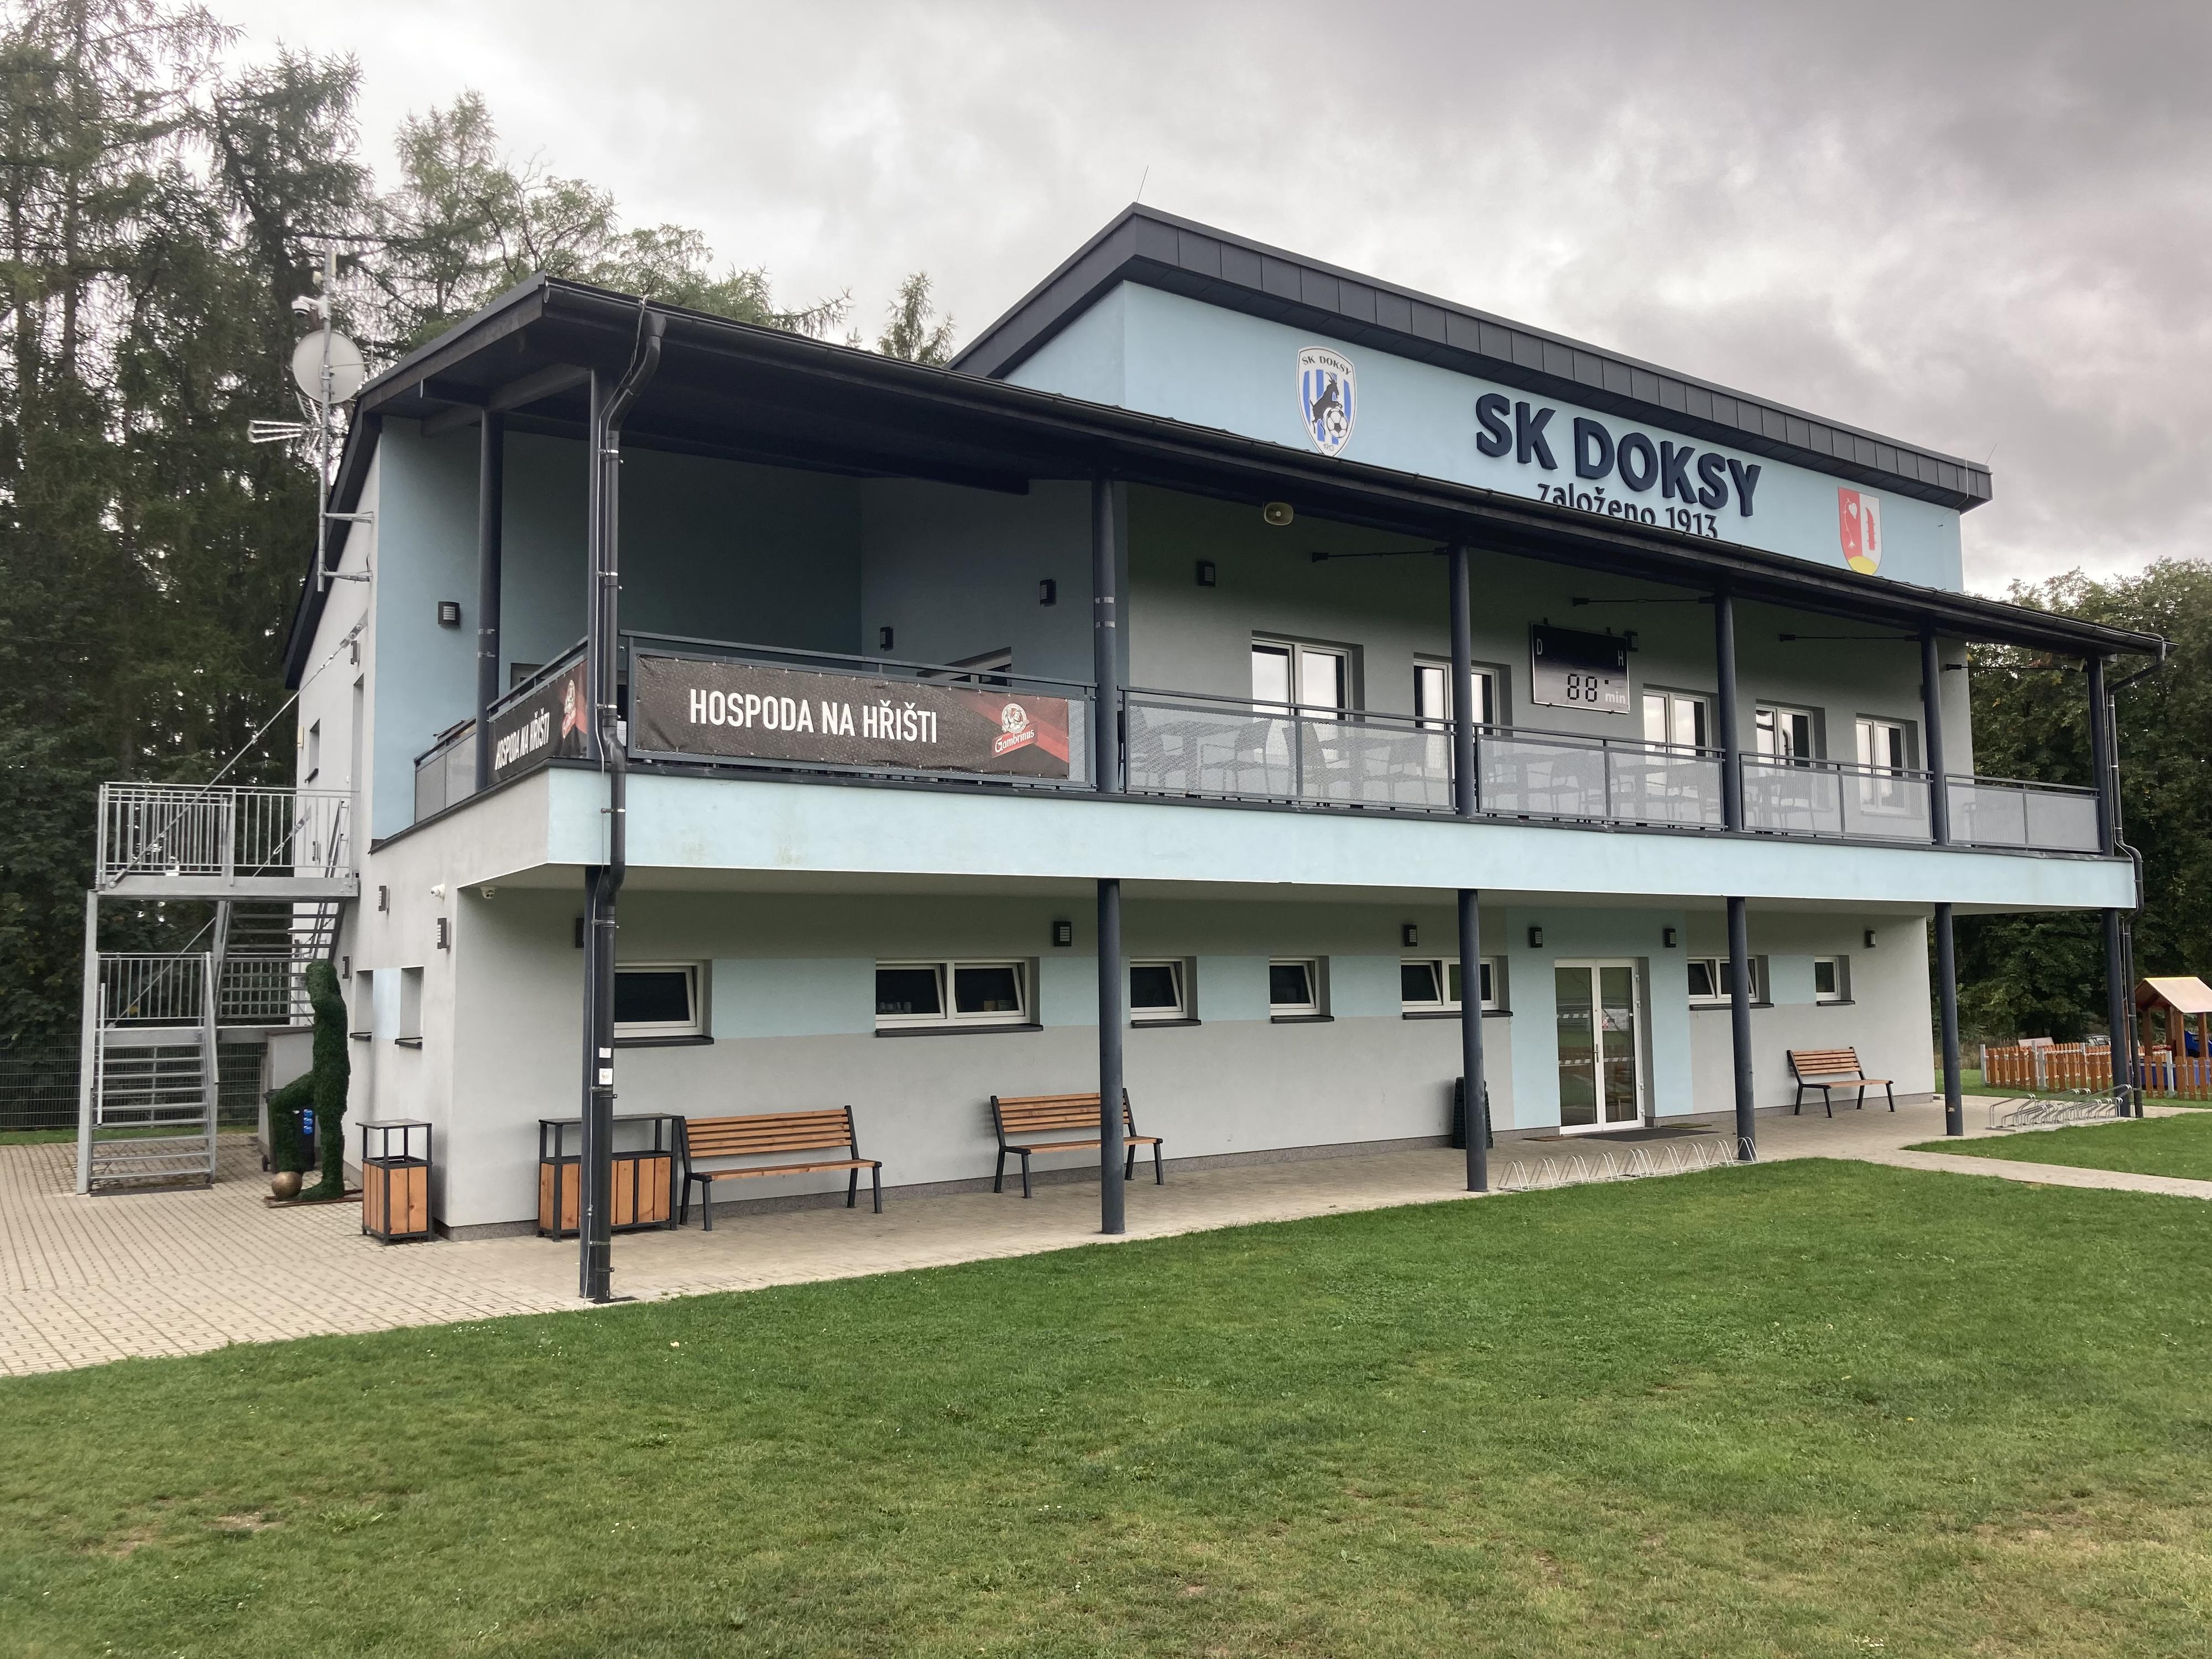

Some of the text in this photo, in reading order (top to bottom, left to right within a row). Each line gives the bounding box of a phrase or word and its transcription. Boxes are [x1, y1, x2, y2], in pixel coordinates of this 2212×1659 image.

[1302, 356, 1352, 375] SK DOKSY
[1475, 393, 1762, 517] SK DOKSY
[1537, 483, 1718, 539] založeno 1913
[1537, 638, 1543, 655] D
[1618, 650, 1624, 666] H
[1605, 691, 1626, 704] min
[690, 688, 937, 743] HOSPODA NA HŘIŠTI
[495, 729, 519, 770] HOSPODA
[520, 724, 529, 757] NA
[530, 708, 550, 752] HŘIŠTI
[995, 729, 1035, 753] Gambrinus
